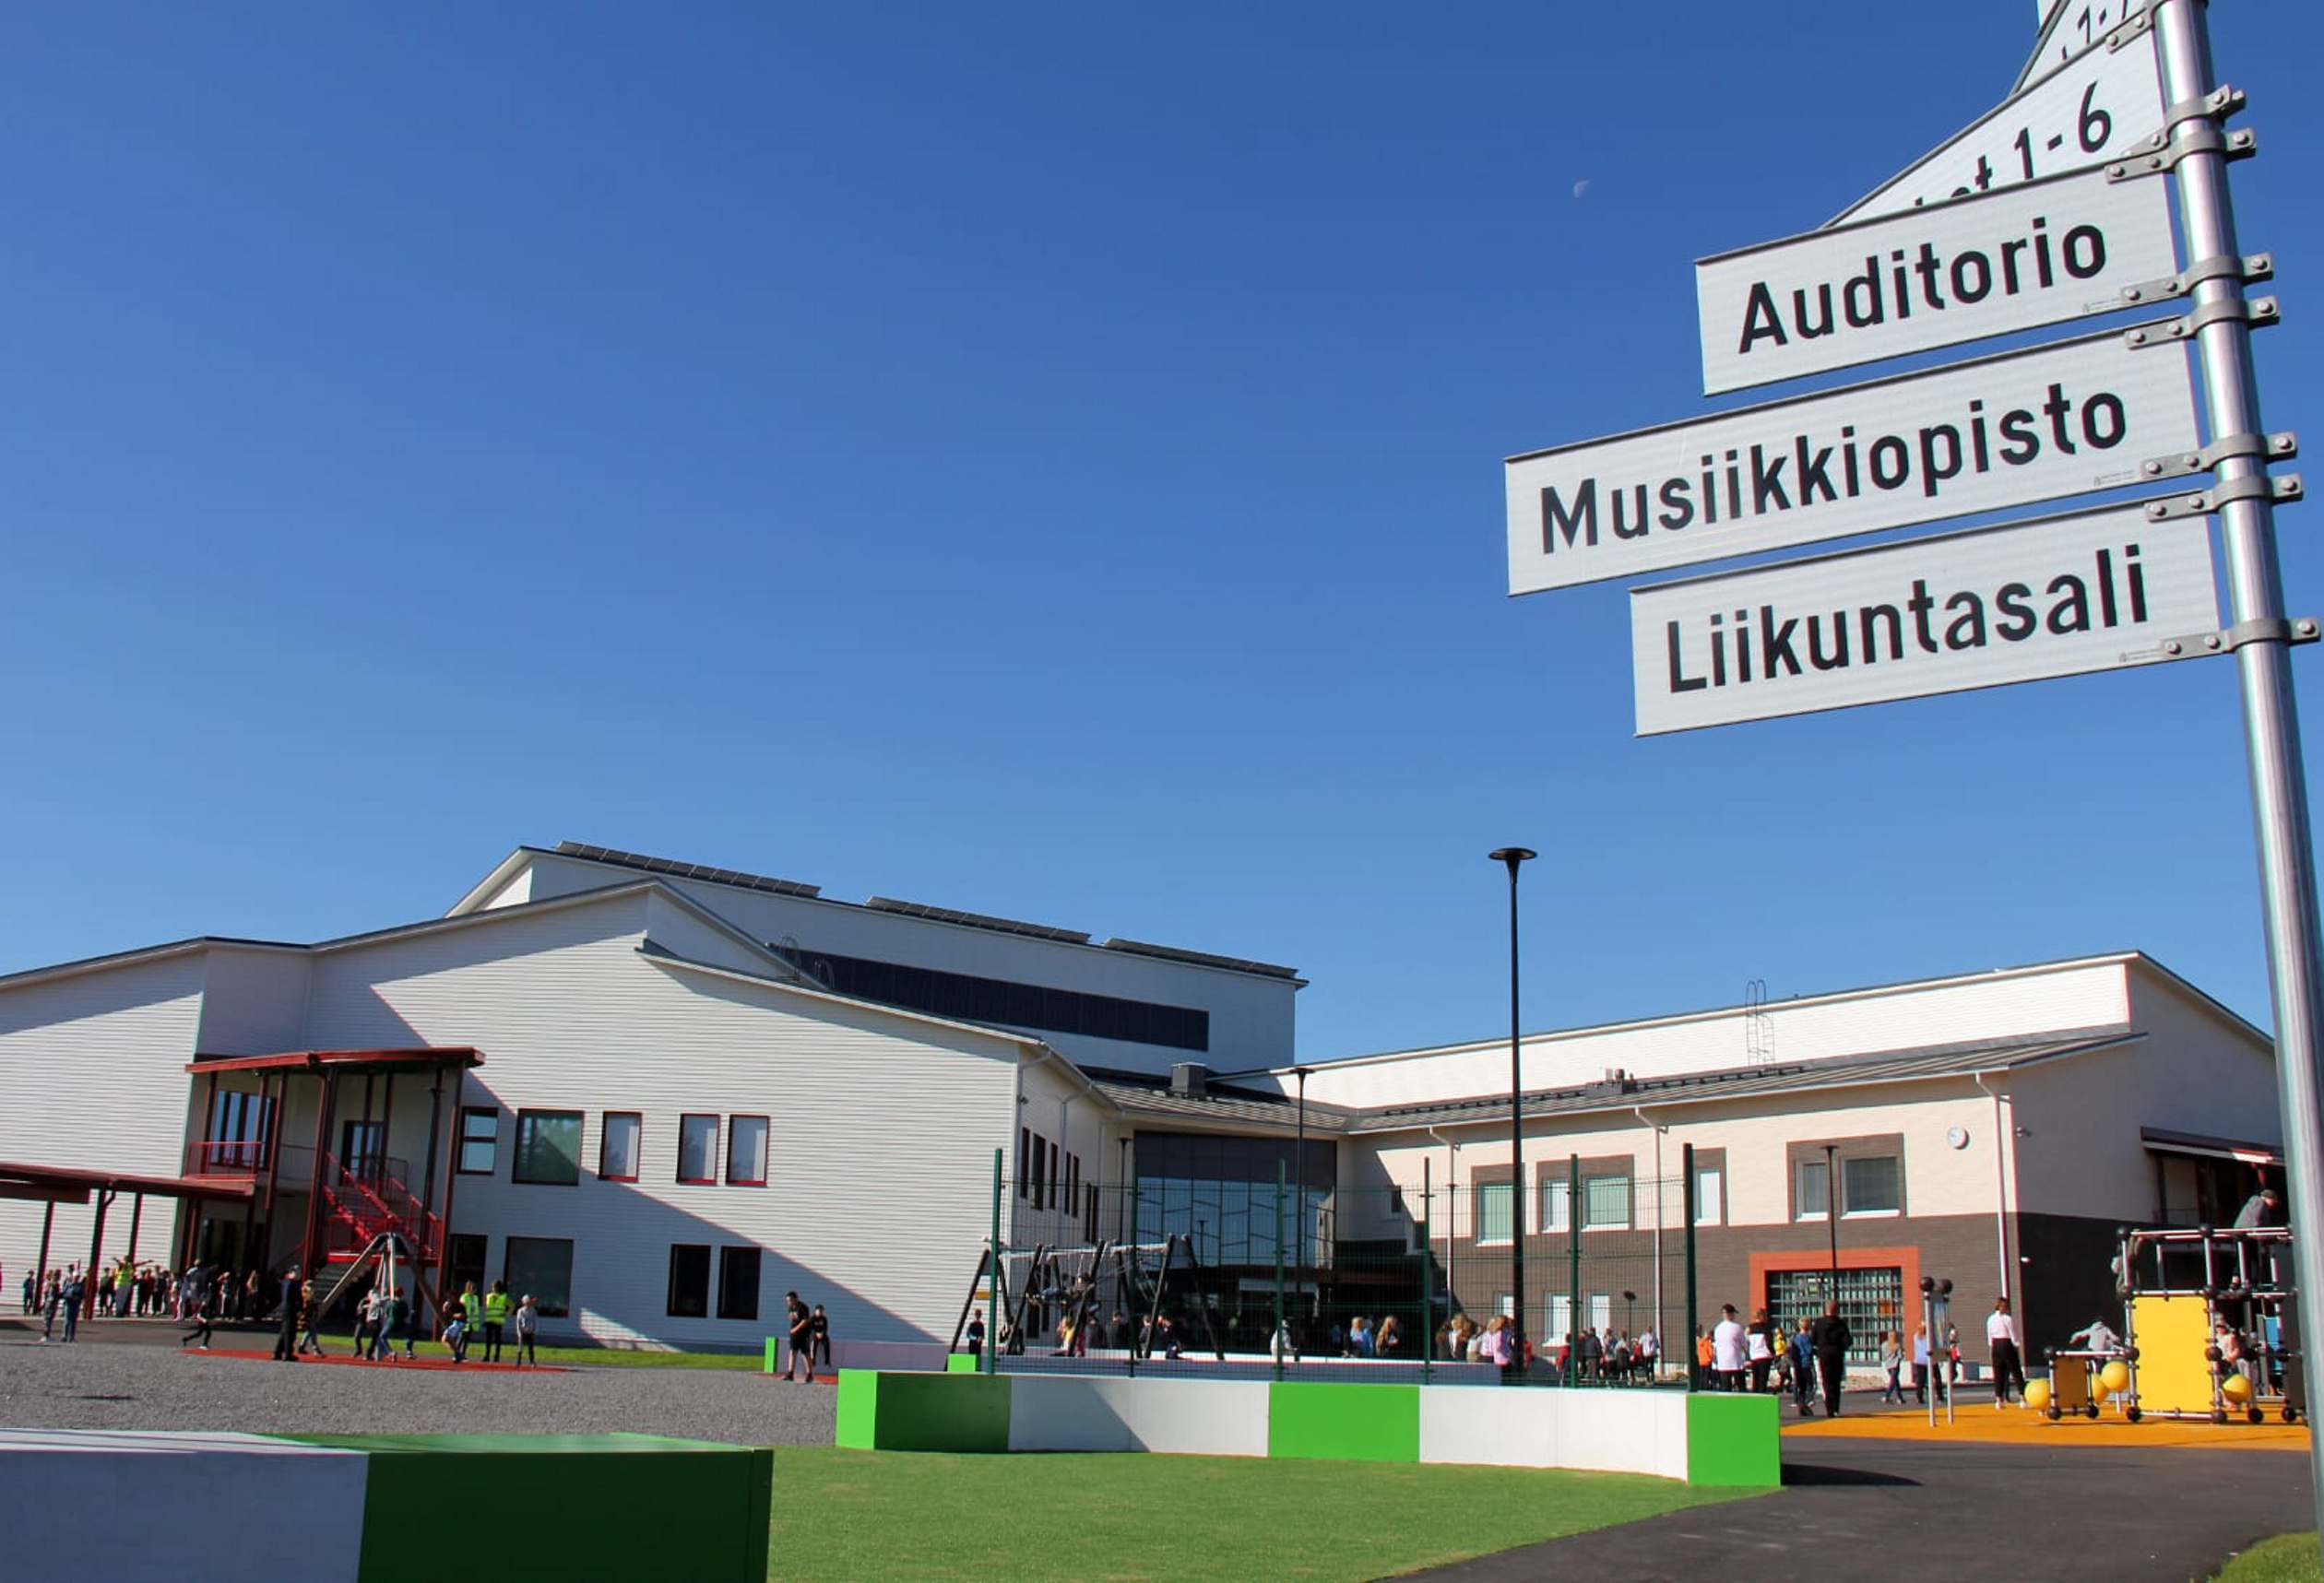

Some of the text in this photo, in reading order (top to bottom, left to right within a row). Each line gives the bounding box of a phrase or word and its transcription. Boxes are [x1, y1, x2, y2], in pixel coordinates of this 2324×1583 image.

[1738, 217, 2106, 354] Auditorio
[1541, 383, 2126, 554] Musiikkiopisto
[1667, 543, 2148, 693] Liikuntasali
